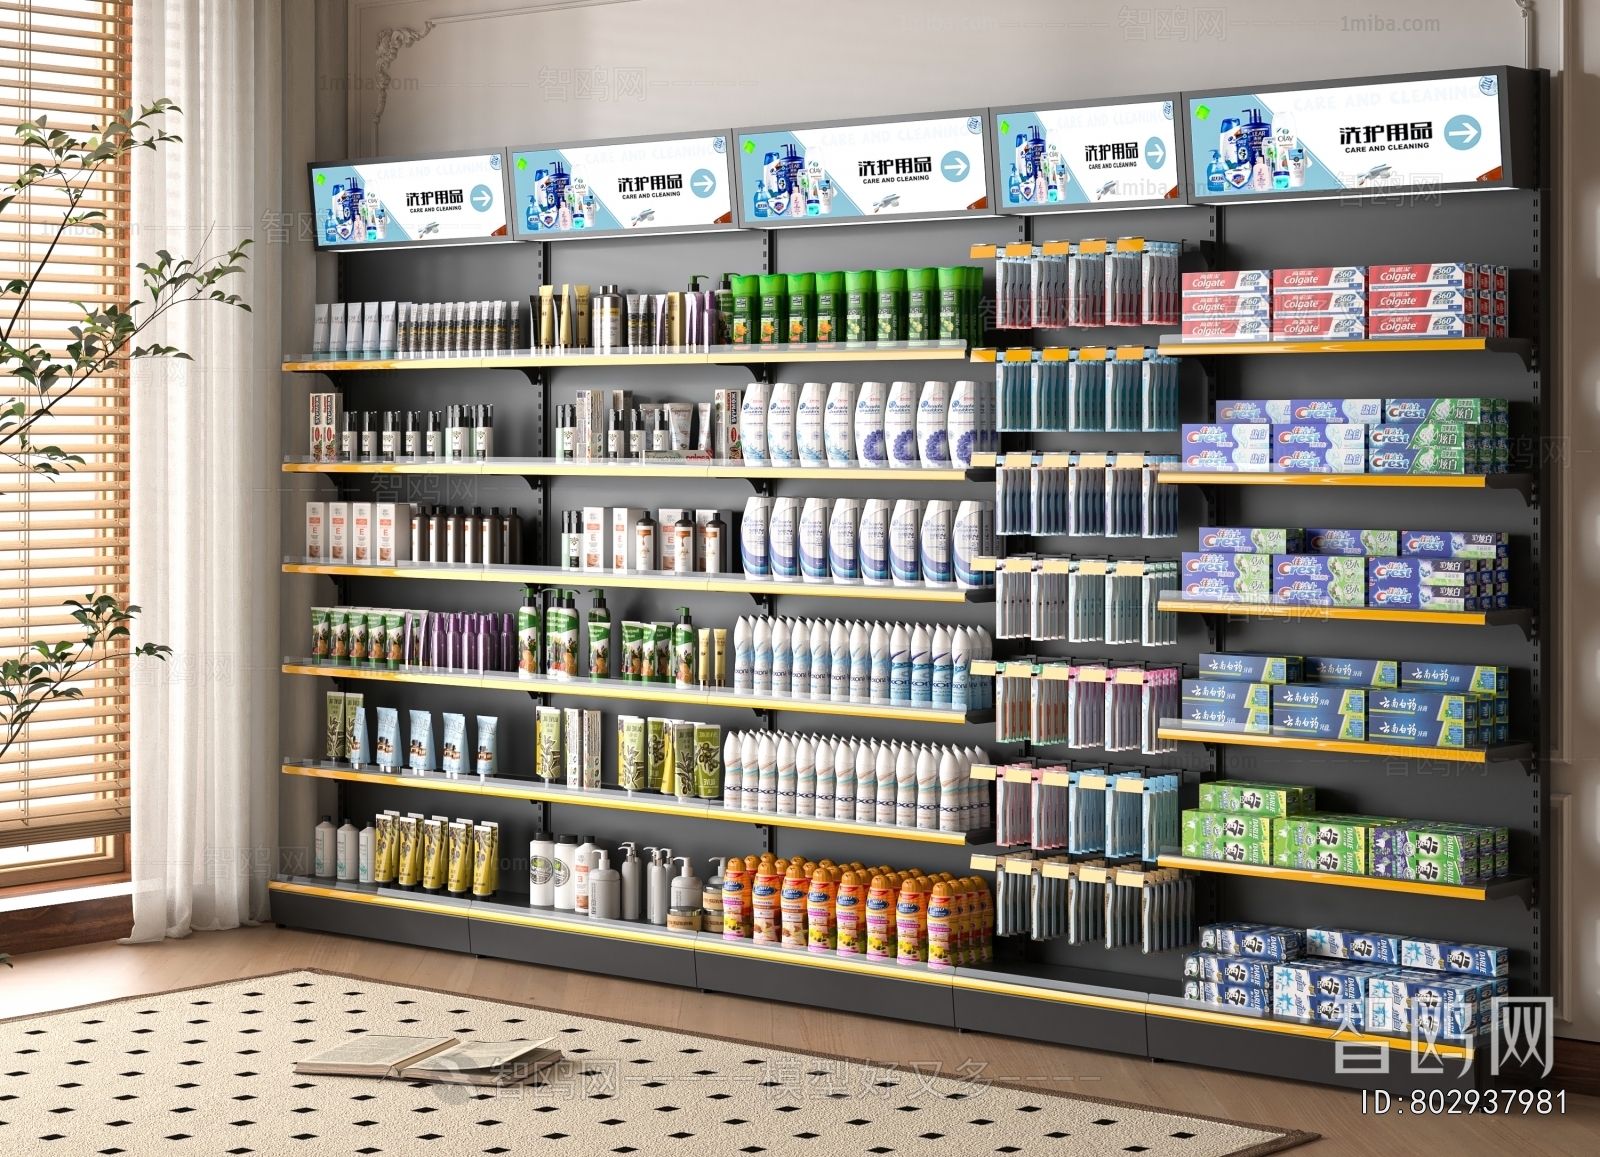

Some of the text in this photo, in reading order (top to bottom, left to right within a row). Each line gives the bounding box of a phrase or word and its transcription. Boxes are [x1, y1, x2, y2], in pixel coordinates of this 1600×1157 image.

[1339, 122, 1433, 146] 洗护用品
[1084, 142, 1138, 162] 洗护用品
[1388, 142, 1430, 150] CLEANING
[858, 156, 932, 177] 洗护用品
[618, 174, 683, 193] 洗护用品
[406, 189, 464, 207] 洗护用品
[1192, 279, 1226, 288] Colgate
[1284, 276, 1318, 285] Colgate
[1380, 272, 1416, 282] Colgate
[1192, 303, 1226, 312] Colgate
[1284, 300, 1318, 310] Colgate
[1380, 297, 1416, 307] Colgate
[1192, 327, 1226, 336] Colgate
[1284, 325, 1318, 334] Colgate
[1380, 322, 1416, 332] Colgate
[1221, 408, 1262, 419] Crest
[1295, 406, 1337, 419] Crest
[1389, 407, 1426, 418] Crest
[1187, 431, 1227, 443] Crest
[1278, 431, 1320, 444] Crest
[1372, 433, 1409, 444] Crest
[1187, 455, 1227, 468] Crest
[1278, 456, 1320, 469] Crest
[1372, 458, 1409, 468] Crest
[1203, 534, 1246, 547] Crest
[1311, 536, 1355, 549] Crest
[1408, 540, 1444, 551] Crest
[1186, 559, 1228, 572] Crest
[1278, 562, 1322, 575] Crest
[1376, 565, 1412, 578] Crest
[1186, 583, 1228, 596] Crest
[1278, 586, 1322, 600] Crest
[1376, 590, 1412, 603] Crest
[1209, 659, 1242, 672] 云南白药
[1317, 662, 1352, 676] 云南白药
[1412, 668, 1449, 681] 云南白药
[1192, 684, 1226, 698] 云南白药
[1283, 690, 1319, 705] 云南白药
[1379, 696, 1417, 711] 云南白药
[1192, 709, 1226, 723] 云南白药
[1283, 715, 1319, 729] 云南白药
[1379, 722, 1417, 736] 云南白药
